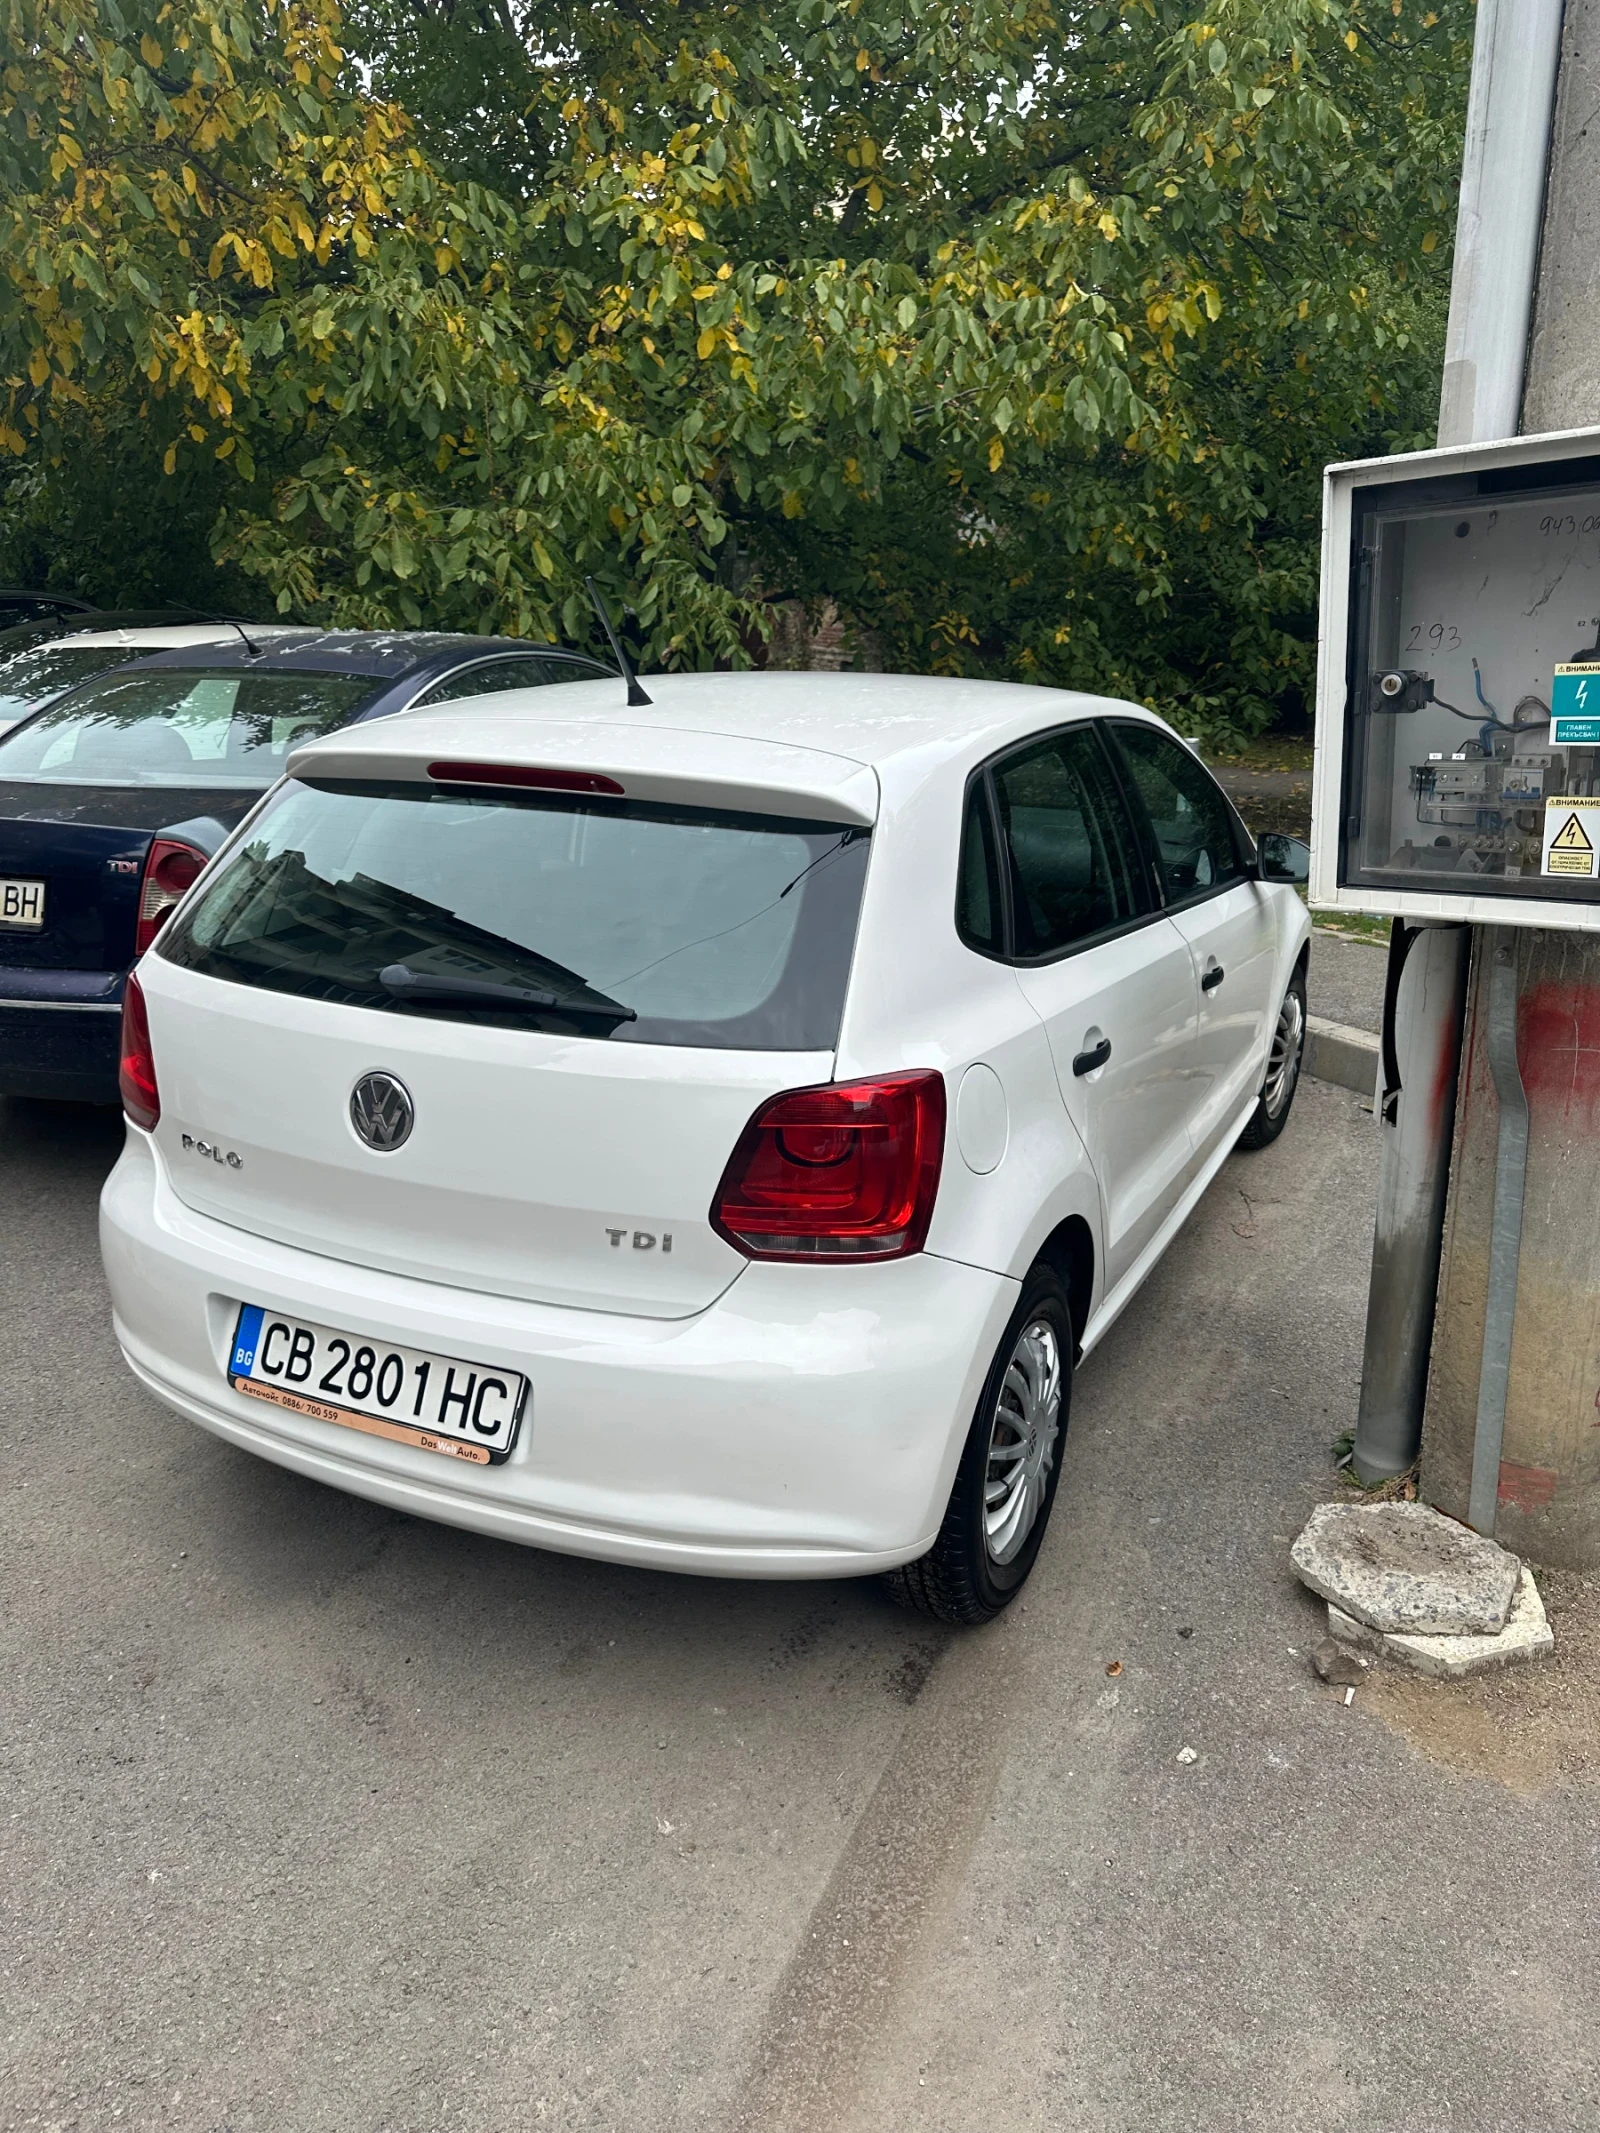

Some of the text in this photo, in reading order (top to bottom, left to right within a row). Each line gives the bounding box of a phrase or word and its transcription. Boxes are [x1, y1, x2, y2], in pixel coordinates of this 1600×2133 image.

[1405, 623, 1462, 652] 293
[1555, 799, 1600, 807] ВНИМАНИЕ
[106, 859, 139, 874] TDI
[4, 885, 39, 919] BH
[181, 1133, 244, 1170] POLO
[605, 1227, 673, 1253] TDI
[235, 1348, 253, 1367] BG
[260, 1322, 508, 1436] CB 2801 HC
[306, 1404, 321, 1416] 700
[323, 1409, 338, 1421] 559
